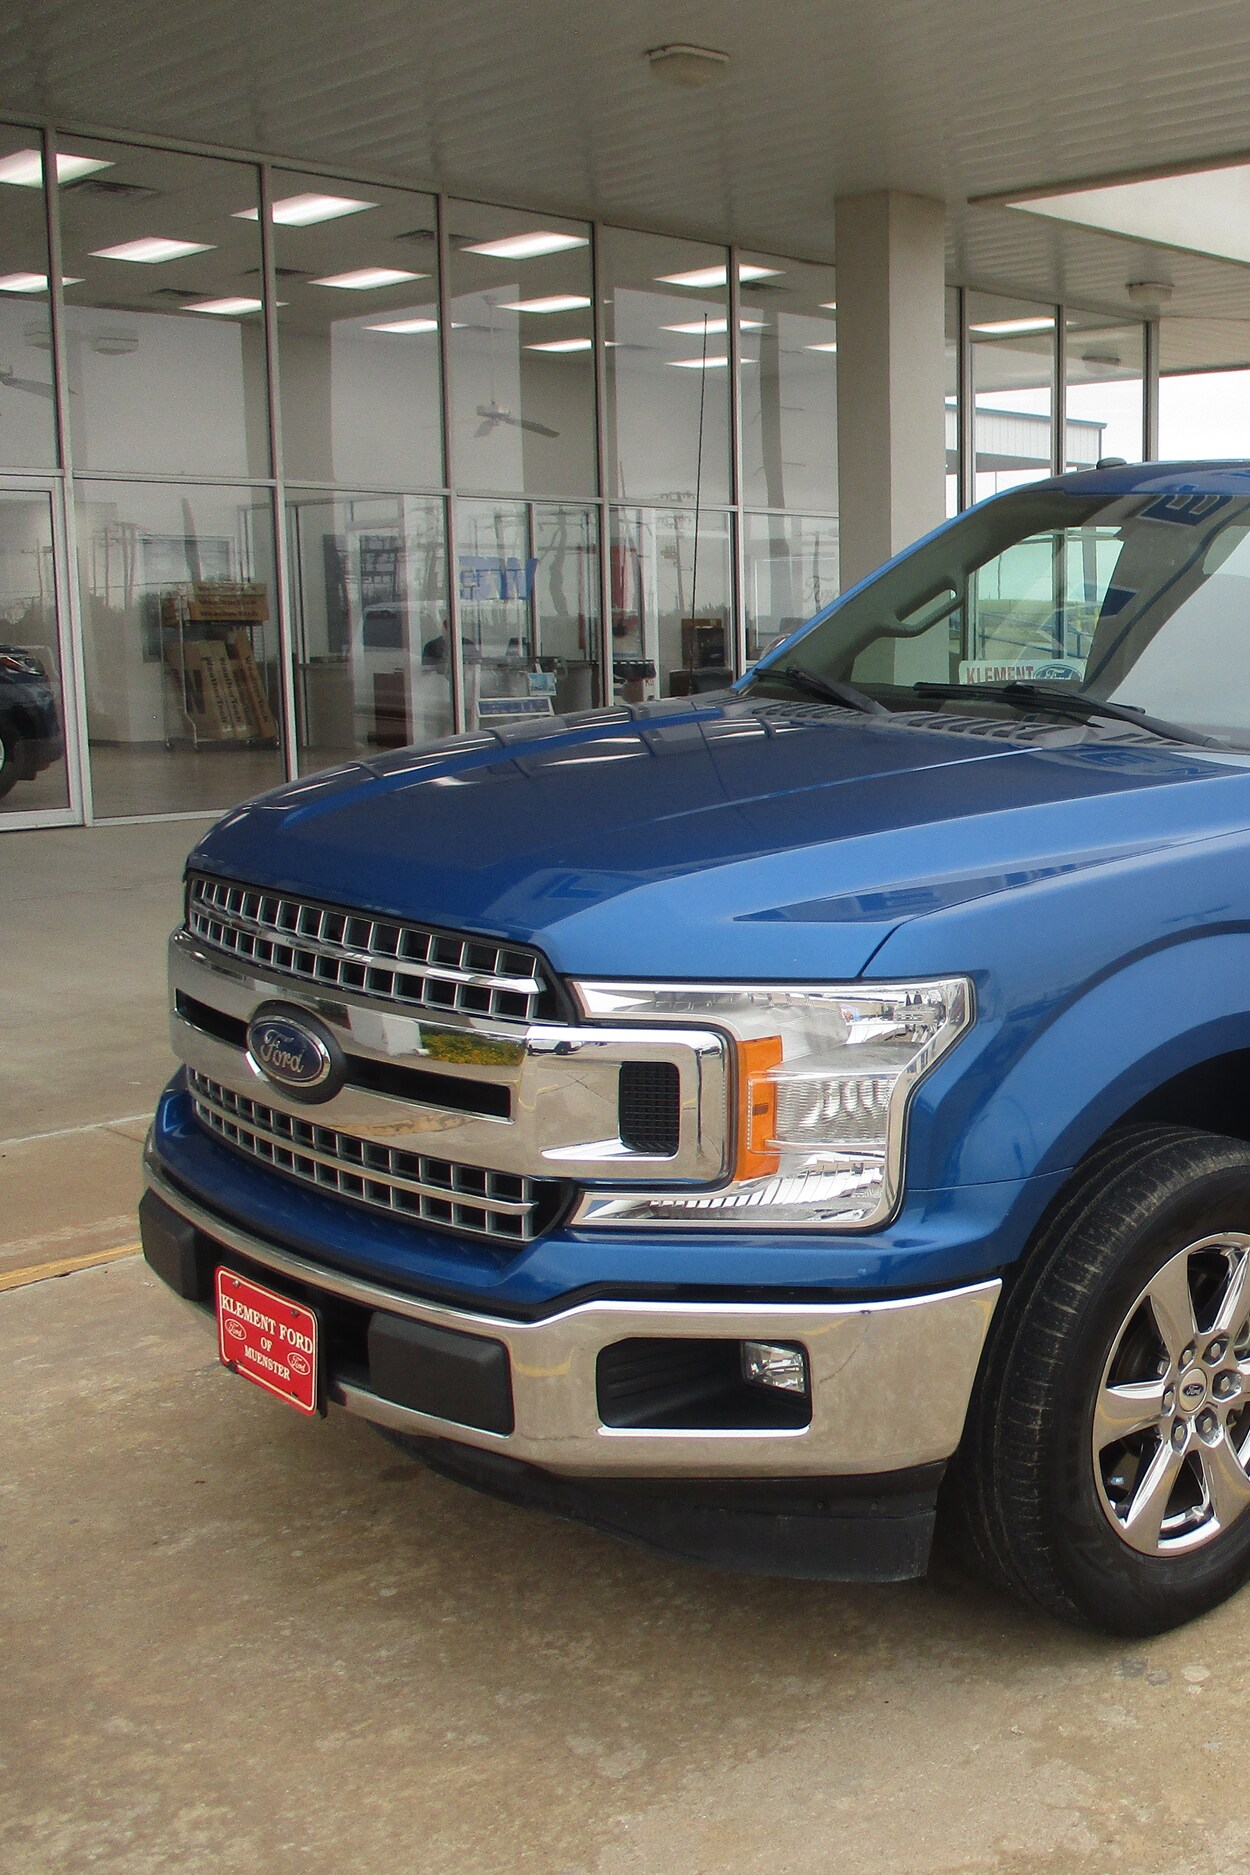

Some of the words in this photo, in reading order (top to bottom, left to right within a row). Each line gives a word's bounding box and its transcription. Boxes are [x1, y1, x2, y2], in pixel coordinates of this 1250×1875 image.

[260, 1029, 305, 1073] Ford
[221, 1294, 276, 1336] KLEMENT
[279, 1323, 313, 1354] FORD
[228, 1321, 244, 1338] Ford
[260, 1337, 273, 1352] OF
[244, 1345, 291, 1381] MUENSTER
[291, 1355, 307, 1373] Ford
